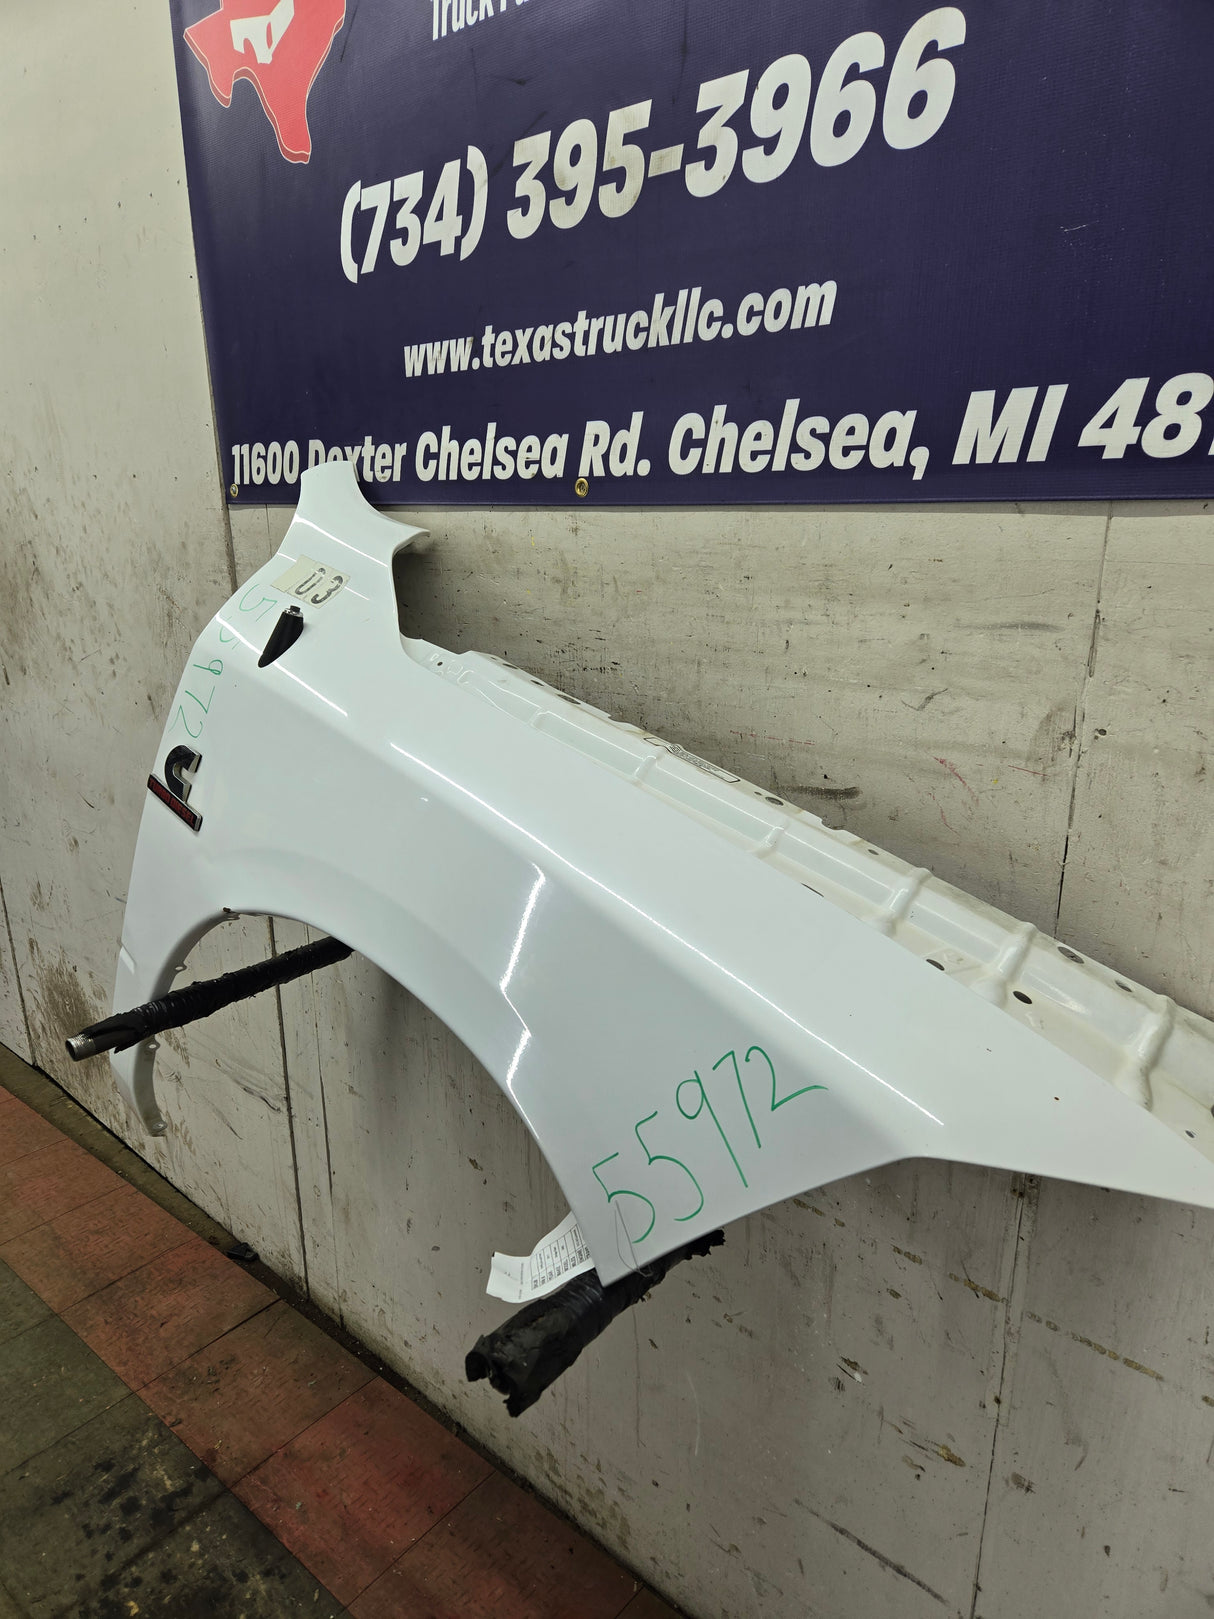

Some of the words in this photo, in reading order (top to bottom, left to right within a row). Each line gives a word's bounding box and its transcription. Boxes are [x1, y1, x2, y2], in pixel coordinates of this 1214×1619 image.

[341, 145, 488, 283] (734)
[507, 6, 966, 239] 395-3966
[404, 280, 837, 377] www.texastruckllc.com
[232, 440, 298, 485] 11600
[415, 422, 569, 482] Chelsea
[578, 411, 651, 477] Rd.
[669, 398, 930, 480] Chelsea,
[952, 384, 1069, 465] MI
[1078, 372, 1214, 460] 48
[591, 1045, 829, 1244] 55972
